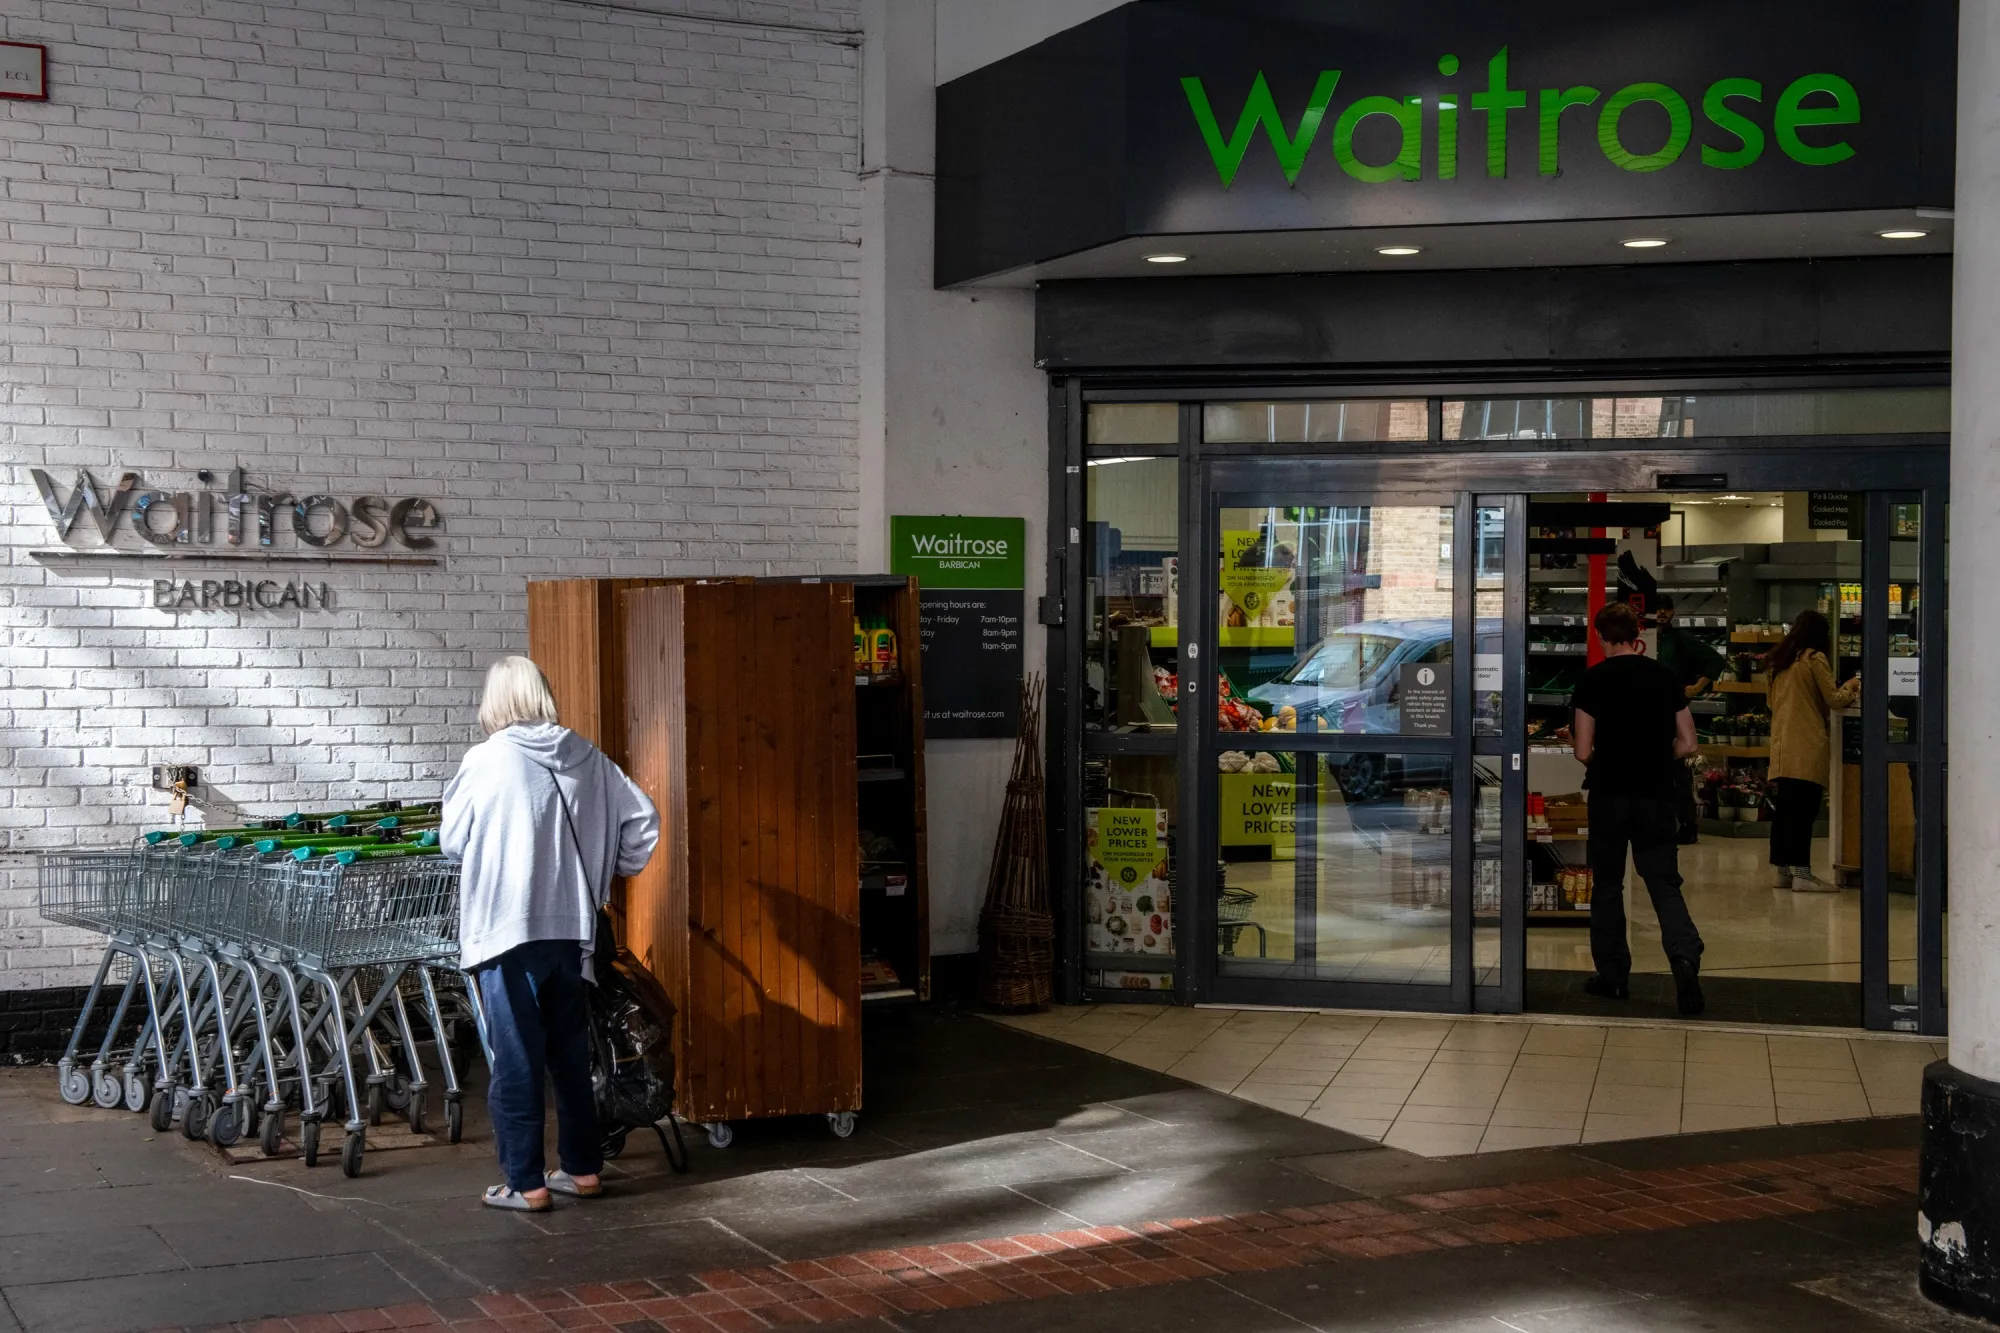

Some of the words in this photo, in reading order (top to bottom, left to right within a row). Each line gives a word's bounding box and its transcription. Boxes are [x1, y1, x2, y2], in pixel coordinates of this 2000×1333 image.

[1180, 44, 1861, 190] Waitrose
[29, 466, 441, 549] Waitrose
[1814, 518, 1835, 526] Cooked
[912, 532, 1008, 555] Waitrose
[940, 560, 980, 568] BARBICAN
[153, 579, 330, 609] BARBICAN
[950, 600, 970, 608] hours
[937, 616, 960, 625] Friday
[980, 616, 1017, 624] 7am-10pm
[982, 629, 1017, 638] 8am-9pm
[982, 642, 1017, 651] 11am-5pm
[942, 710, 950, 719] at
[952, 710, 1005, 718] waitrose.com
[1252, 784, 1290, 797] NEW
[1113, 816, 1141, 825] NEW
[1245, 821, 1296, 833] PRICES
[1107, 828, 1148, 837] LOWER
[1109, 840, 1147, 848] PRICES
[370, 849, 405, 857] Waitrose
